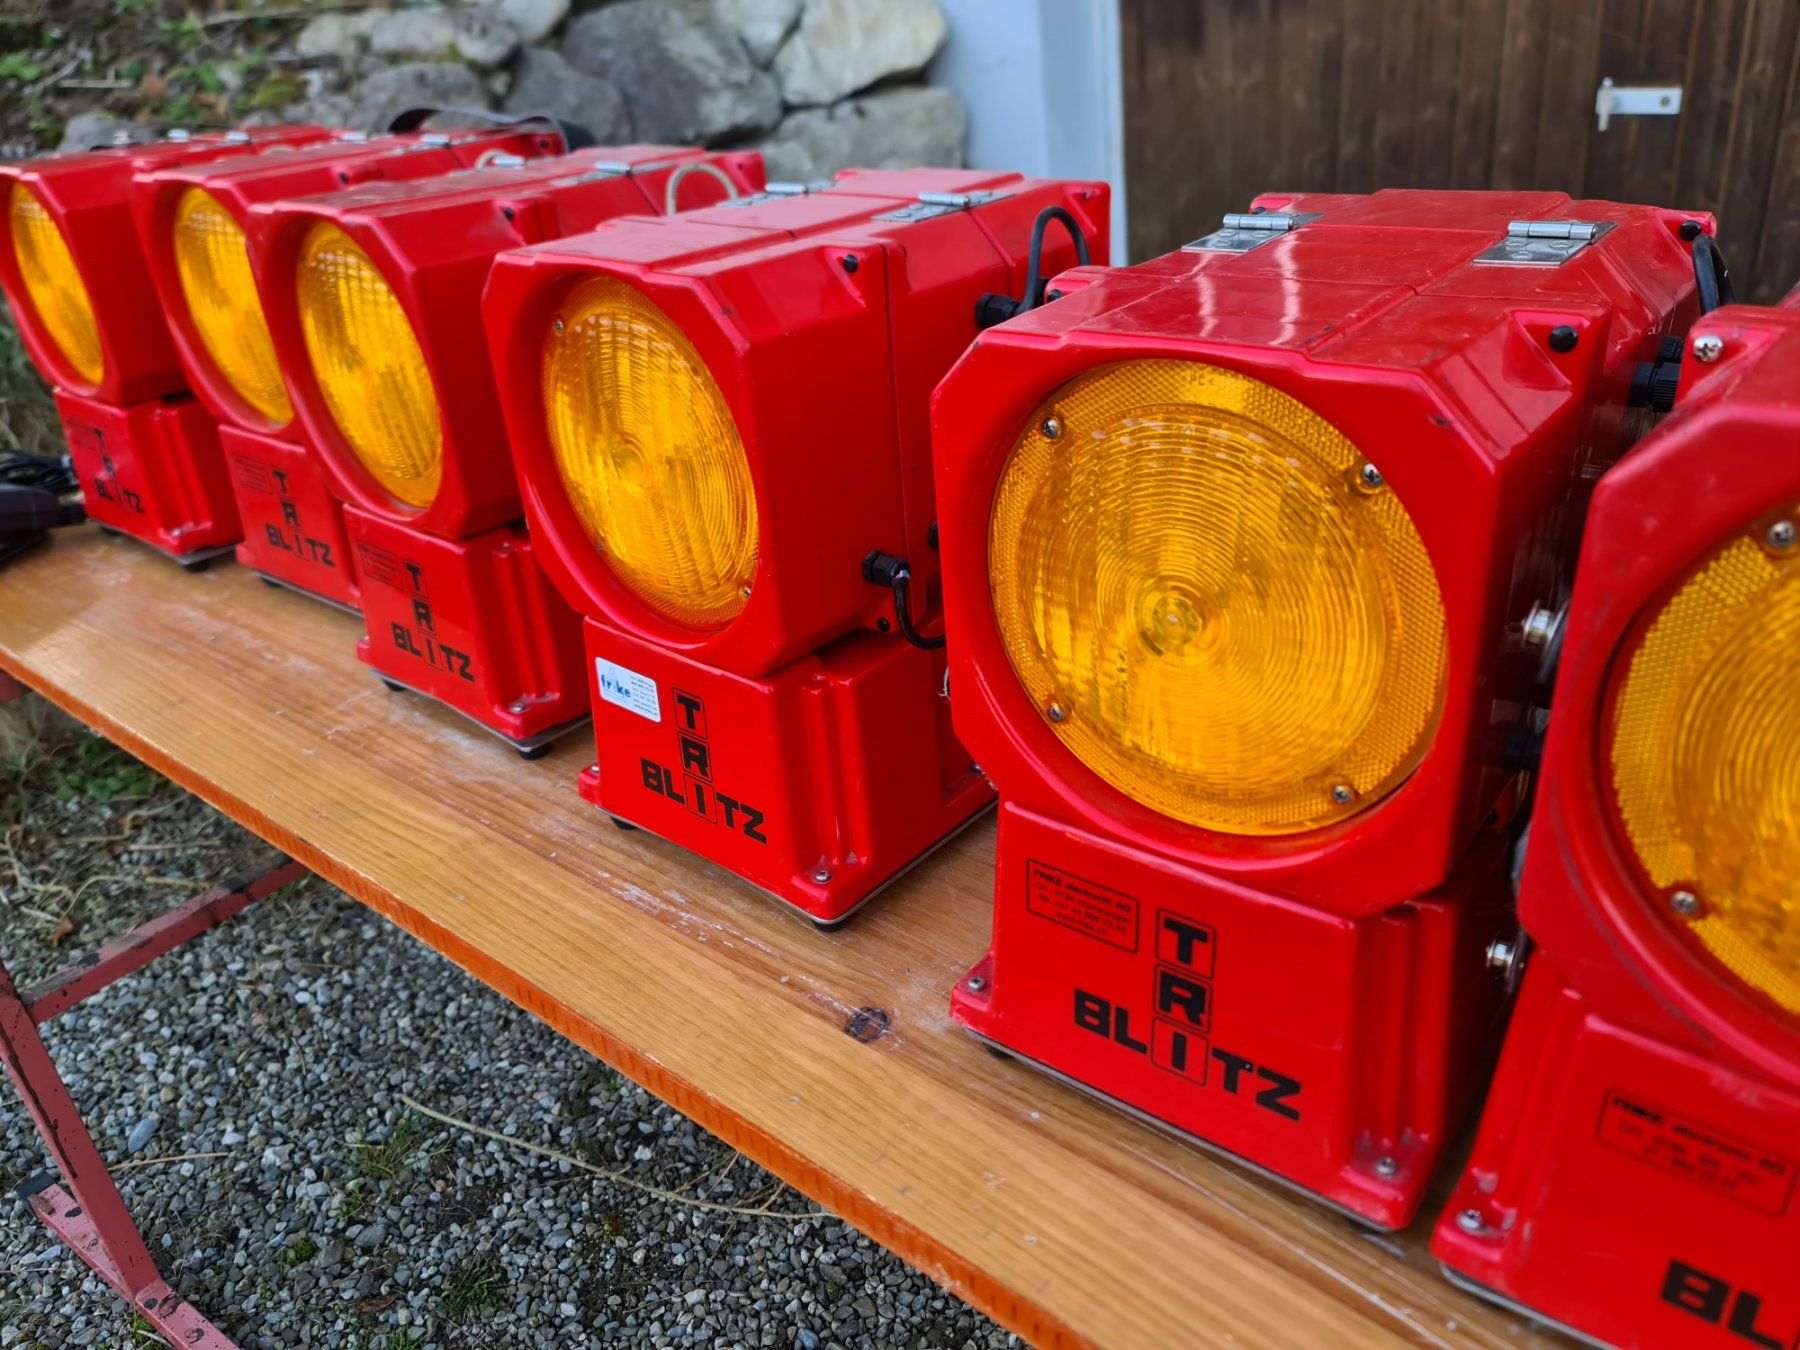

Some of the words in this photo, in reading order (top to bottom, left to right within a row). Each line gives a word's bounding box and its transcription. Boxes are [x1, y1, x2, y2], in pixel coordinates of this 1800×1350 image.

[264, 522, 335, 568] BLITZ
[390, 621, 476, 683] BLITZ
[640, 757, 768, 845] BLITZ
[1073, 987, 1302, 1122] BLITZ
